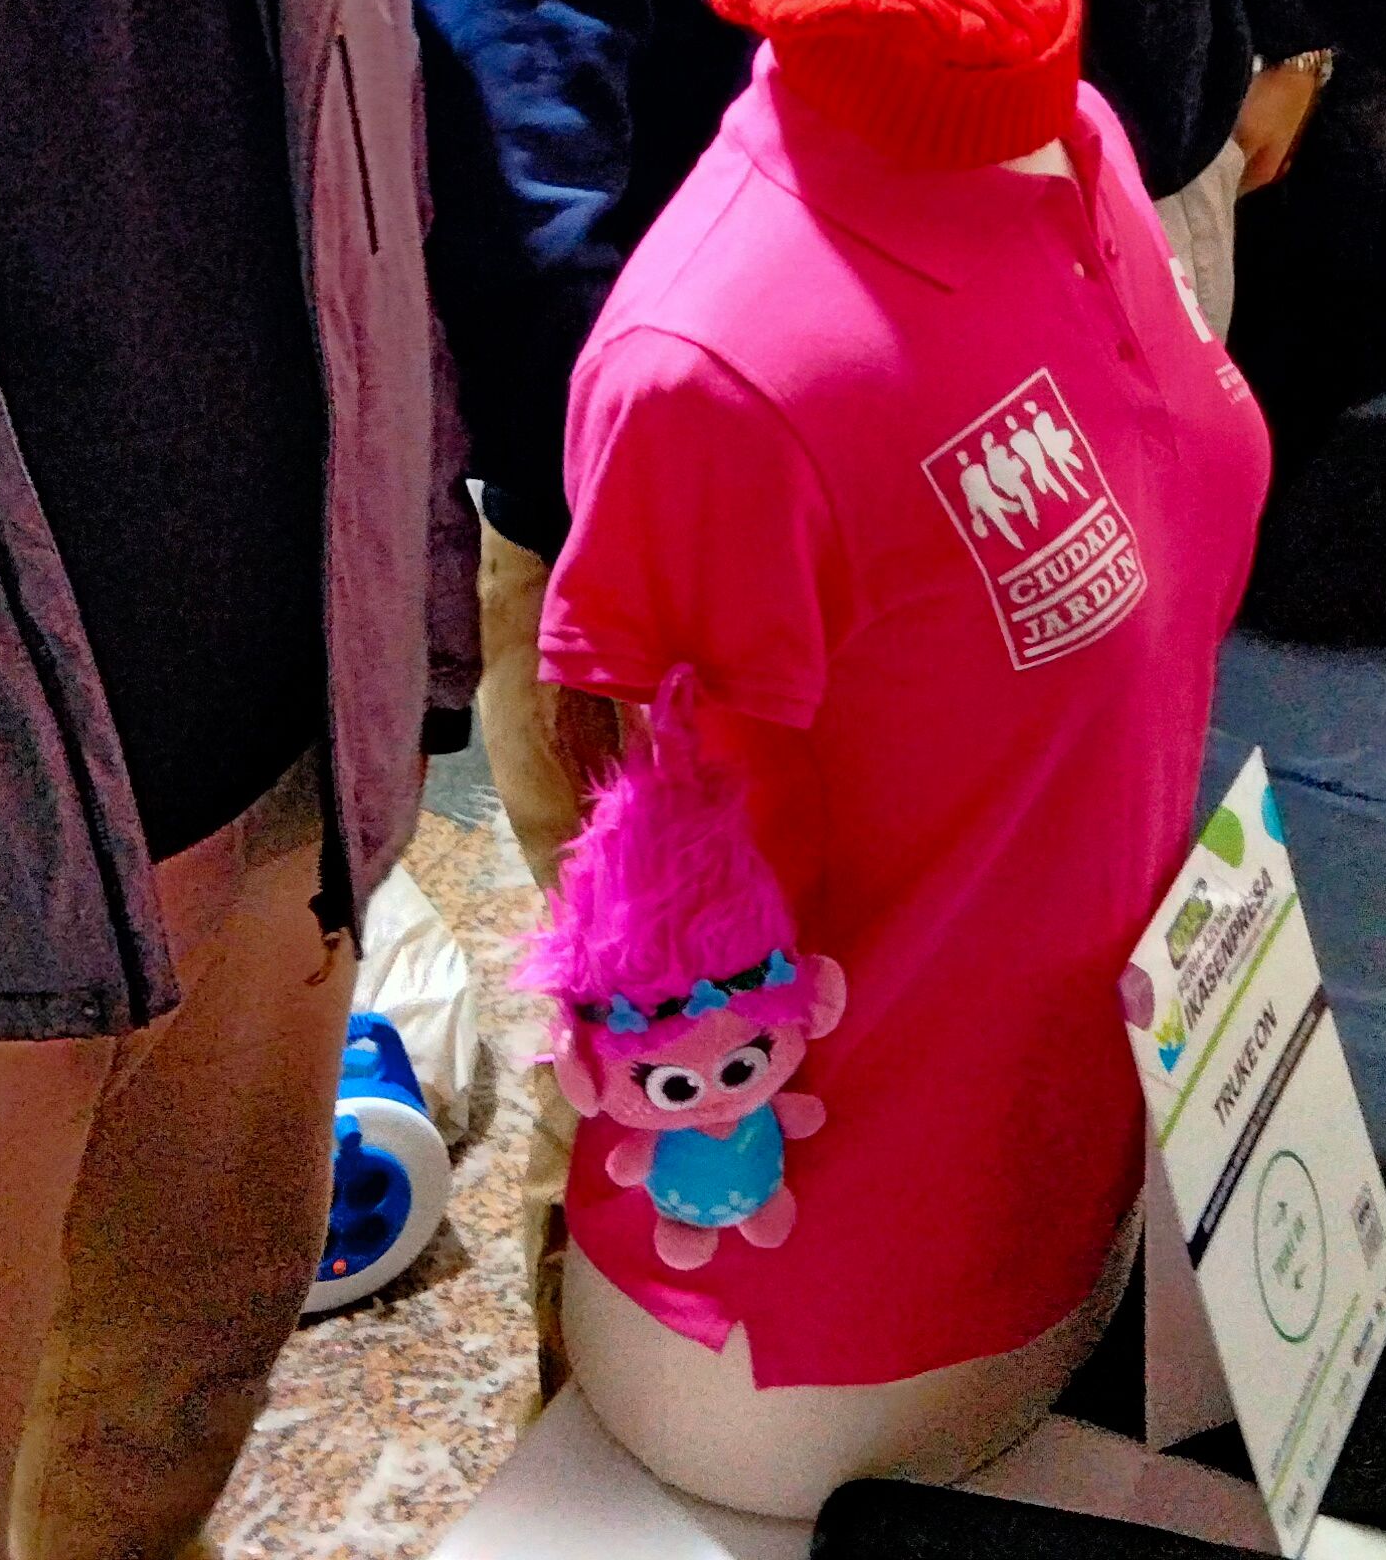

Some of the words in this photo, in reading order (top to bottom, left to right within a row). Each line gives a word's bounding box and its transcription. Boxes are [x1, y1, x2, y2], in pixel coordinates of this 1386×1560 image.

[1009, 514, 1118, 604] CIUDAD
[1022, 547, 1138, 645] JARDIN
[1184, 866, 1273, 1032] IKASENPRESA
[1213, 1034, 1261, 1127] TRUKE
[1254, 1000, 1278, 1050] ON
